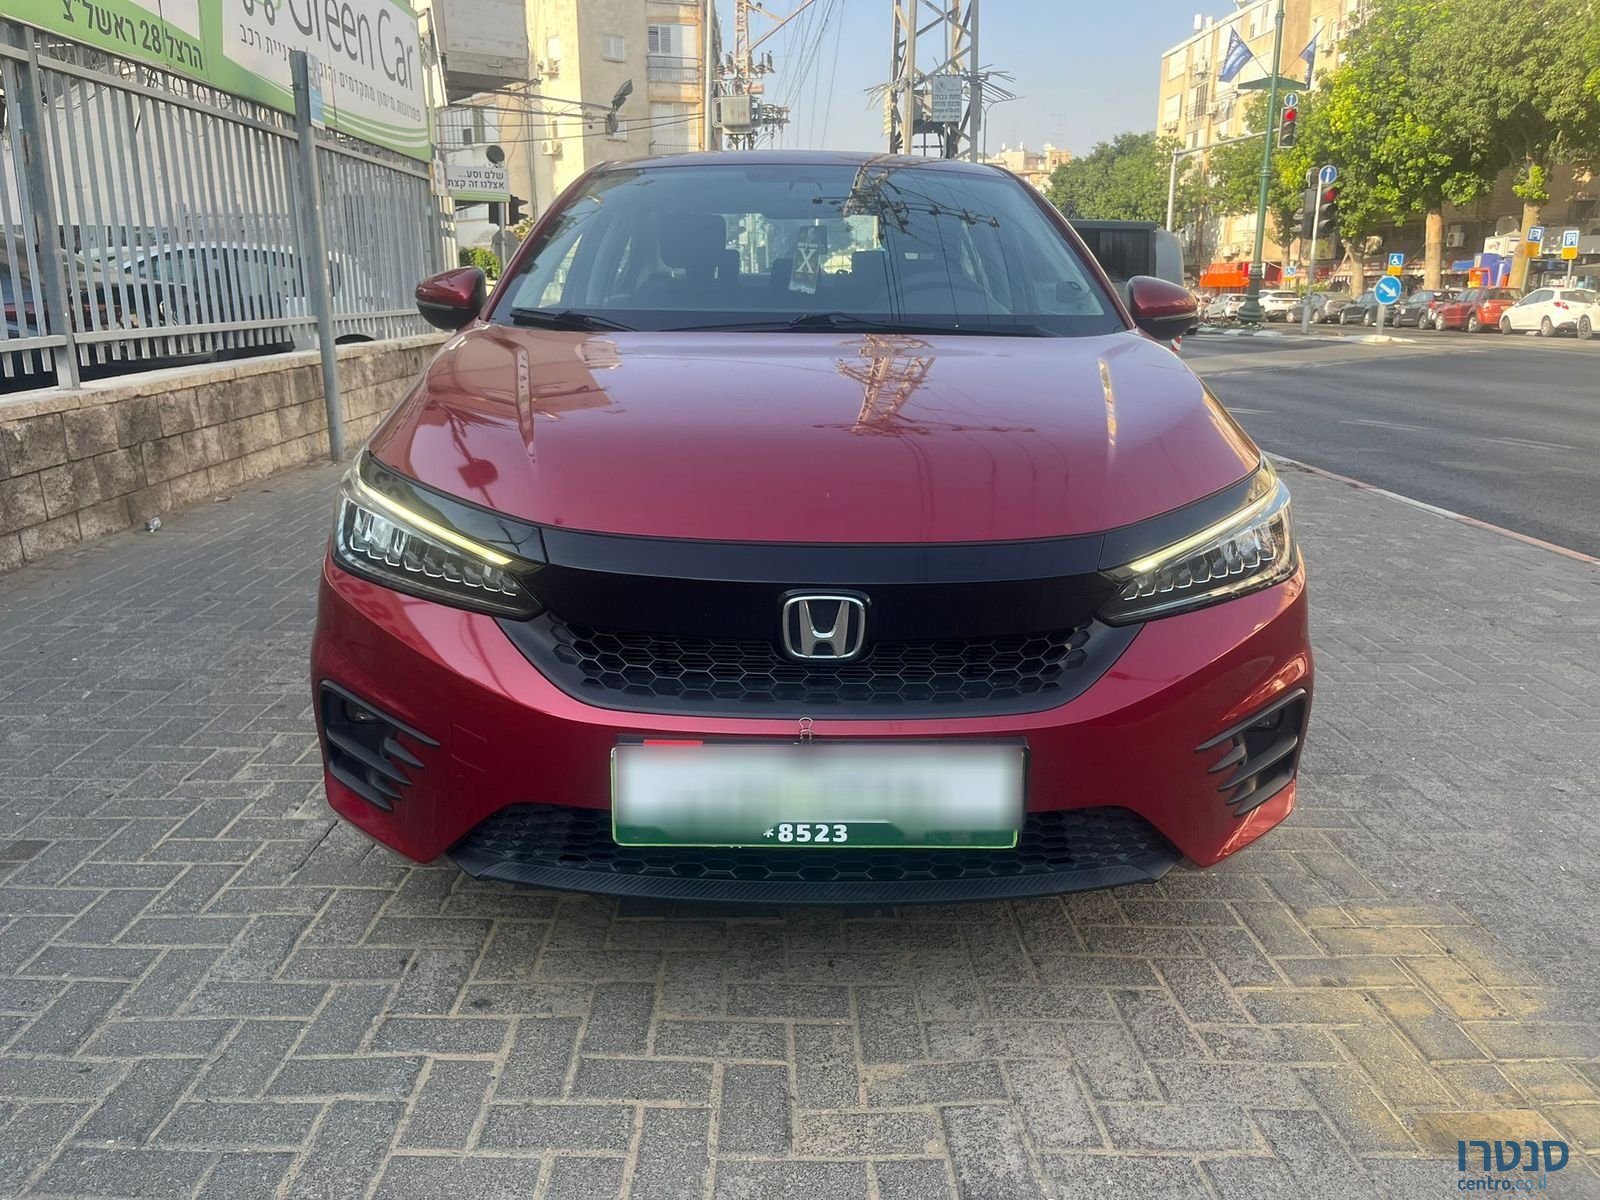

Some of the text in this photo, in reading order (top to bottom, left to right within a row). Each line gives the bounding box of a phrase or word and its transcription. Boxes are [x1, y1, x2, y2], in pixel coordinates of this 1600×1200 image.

[139, 19, 161, 55] 28
[164, 27, 203, 70] הרצל
[239, 23, 262, 51] רכב
[377, 8, 413, 91] Car
[447, 179, 505, 190] אצלנו זה קצת
[485, 170, 504, 180] שלם
